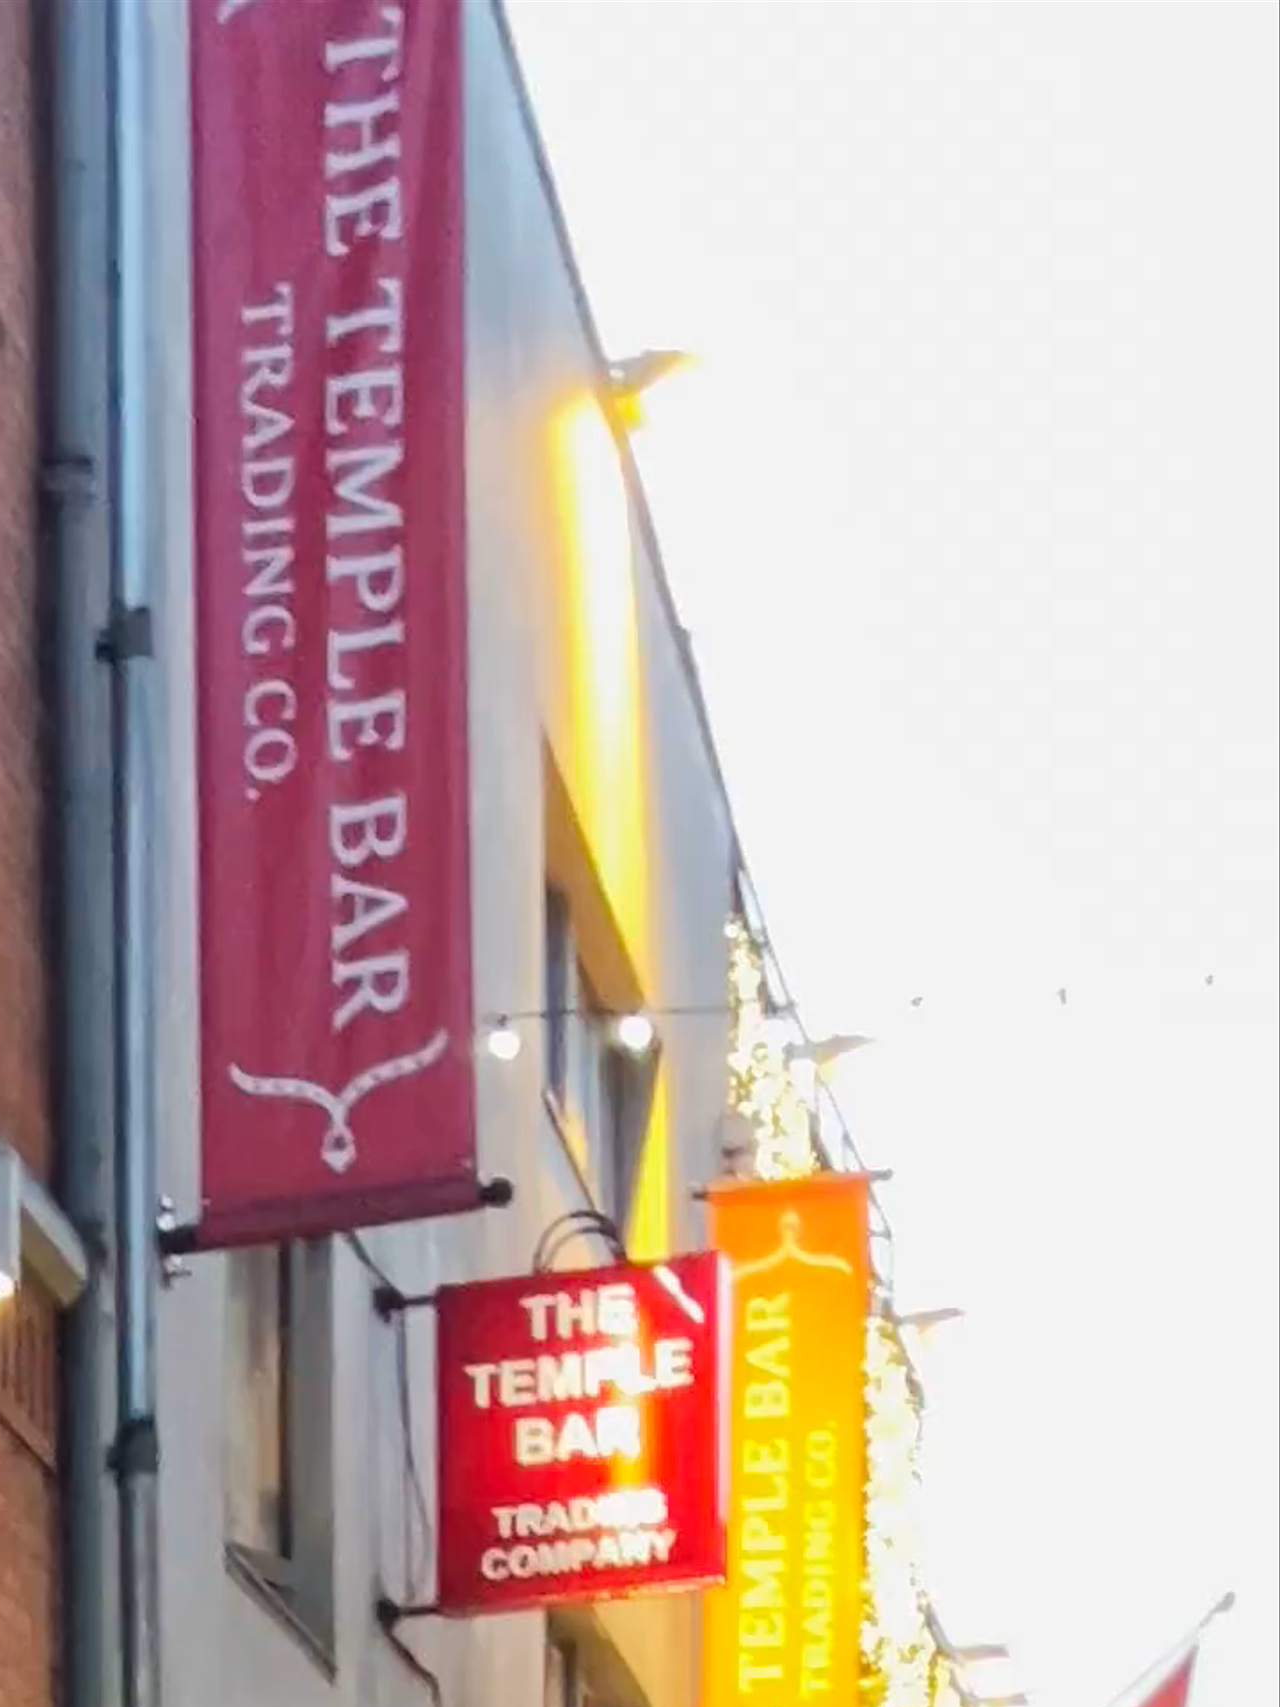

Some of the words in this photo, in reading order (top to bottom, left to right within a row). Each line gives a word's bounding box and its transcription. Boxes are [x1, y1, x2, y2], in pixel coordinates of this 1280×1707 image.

[324, 6, 403, 257] THE
[239, 281, 297, 661] TRADING
[322, 280, 407, 764] TEMPLE
[242, 680, 299, 802] CO.
[323, 792, 412, 1032] BAR
[465, 1337, 696, 1410] TEMPLE
[519, 1282, 639, 1341] THE
[743, 1289, 793, 1421] BAR
[514, 1405, 642, 1467] BAR
[481, 1529, 678, 1581] COMPANY
[737, 1437, 790, 1695] TEMPLE
[798, 1499, 839, 1701] TRADING
